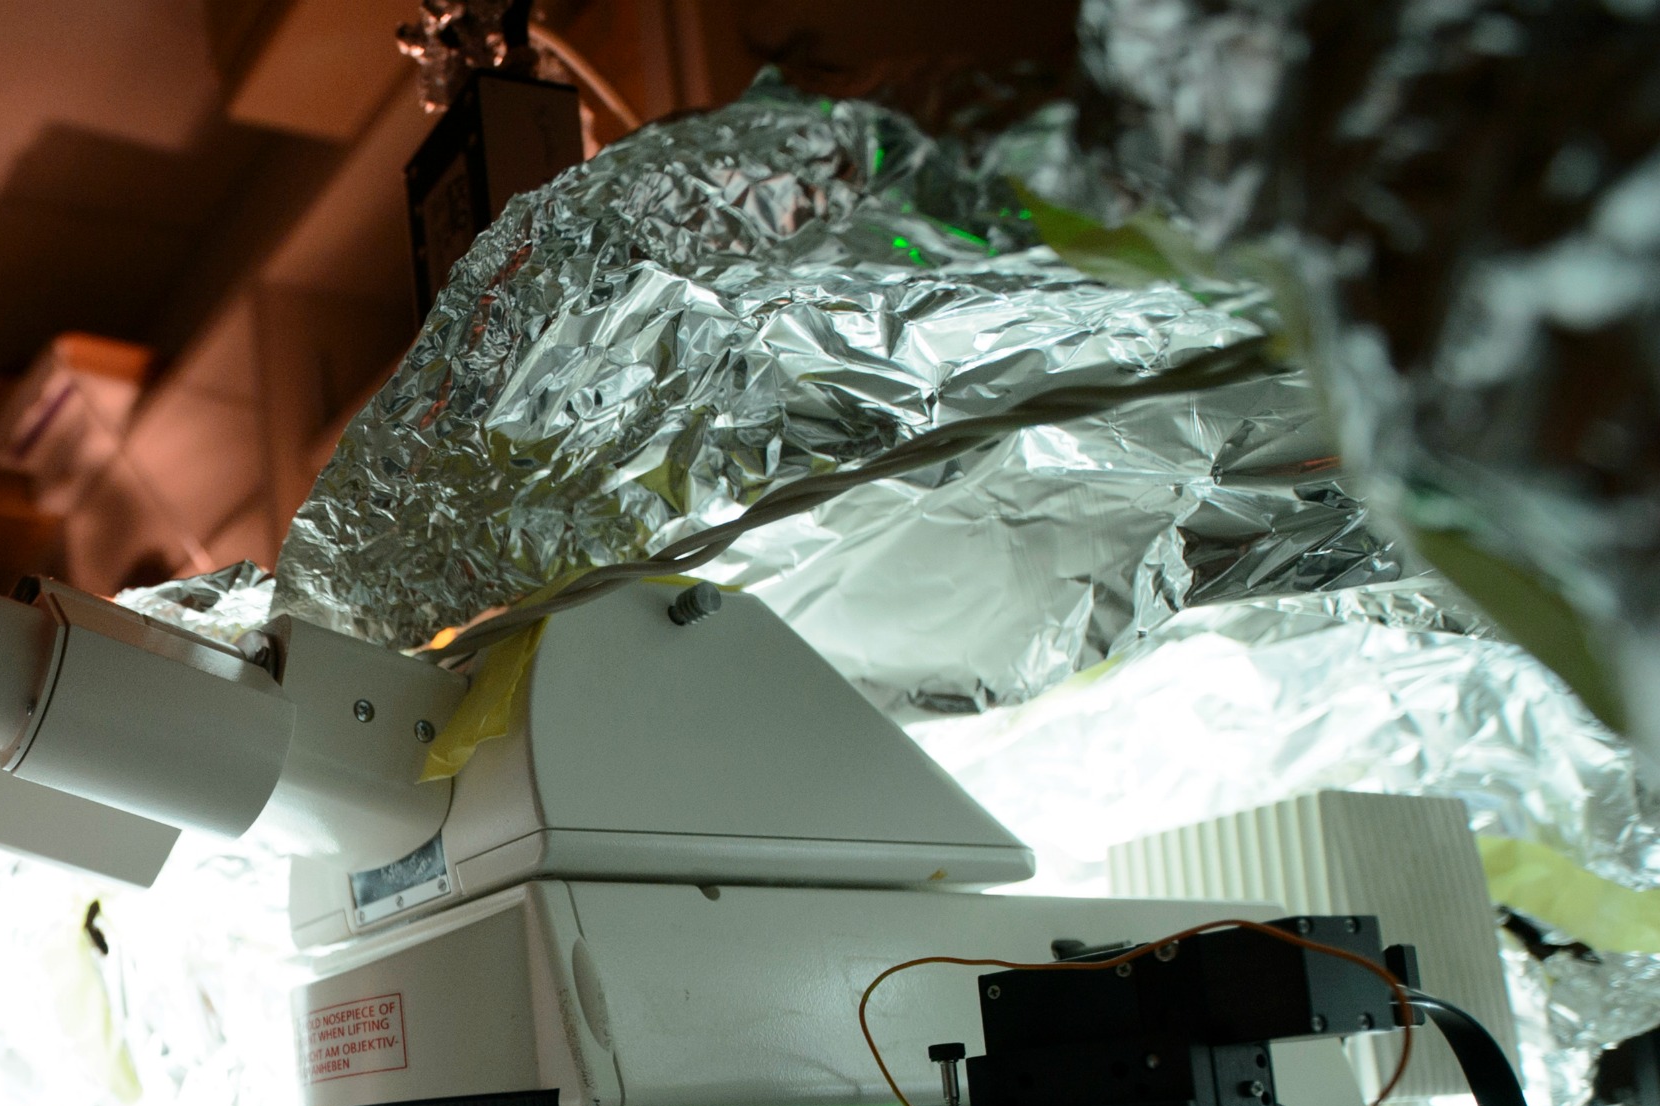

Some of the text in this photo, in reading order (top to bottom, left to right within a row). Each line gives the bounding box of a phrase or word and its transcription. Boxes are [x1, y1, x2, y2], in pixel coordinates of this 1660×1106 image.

[322, 1005, 375, 1026] NOSEPIECE
[378, 1002, 395, 1015] OF
[318, 1027, 345, 1042] WHEN
[348, 1018, 389, 1036] LIFTING
[325, 1046, 339, 1058] AM
[342, 1035, 399, 1055] OBJEKTIV-
[312, 1058, 350, 1076] ANHEBEN
